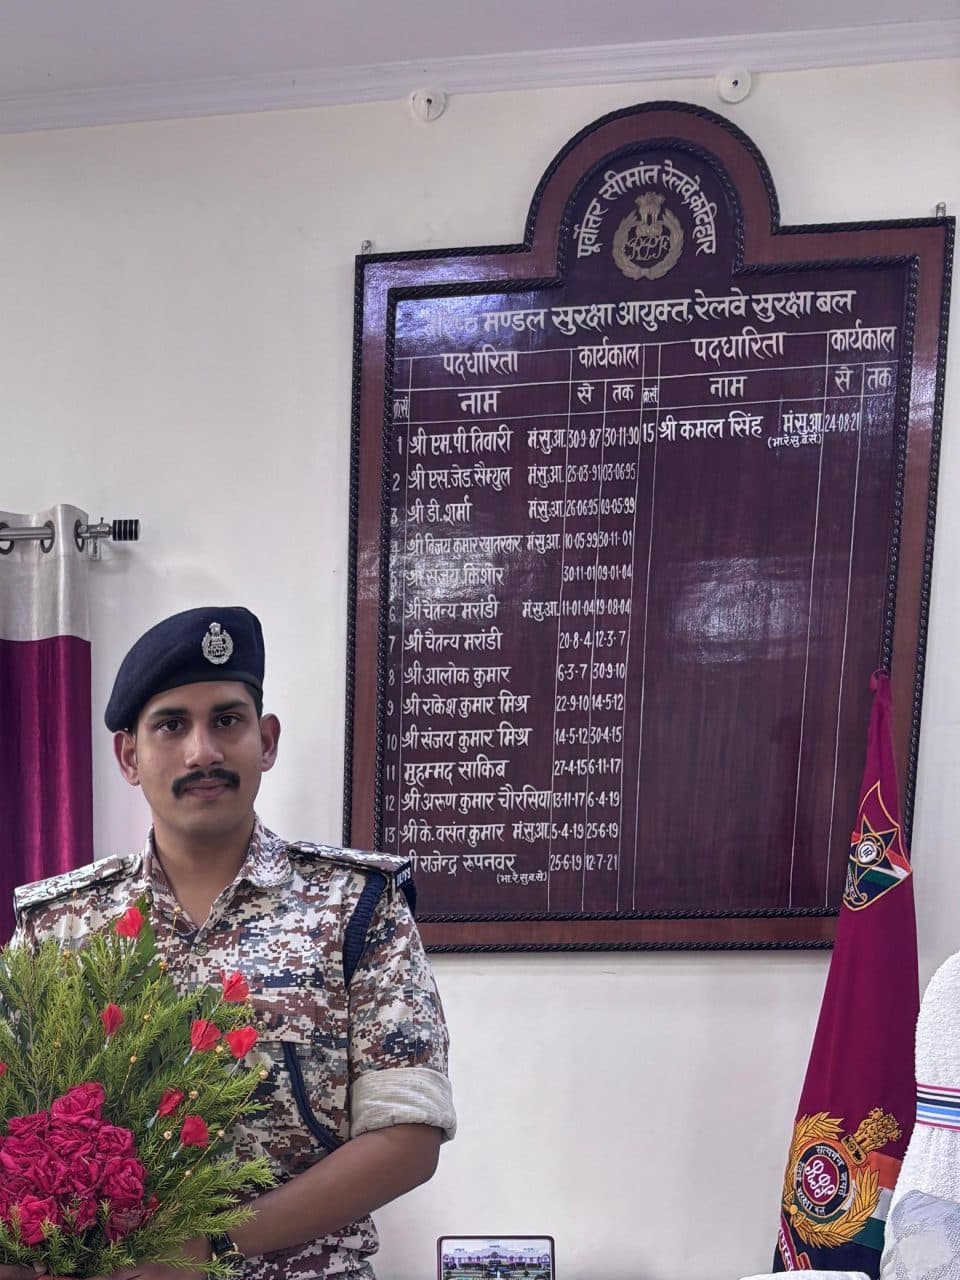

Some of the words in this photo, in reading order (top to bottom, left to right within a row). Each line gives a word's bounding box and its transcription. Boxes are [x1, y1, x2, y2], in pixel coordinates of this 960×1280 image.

[598, 161, 661, 200] सीमांत
[690, 192, 717, 256] कटिहार
[483, 309, 548, 332] मण्डल
[552, 304, 617, 335] सुरक्षा
[694, 288, 750, 321] रेलवे
[752, 291, 815, 323] सुरक्षा
[816, 290, 856, 314] बल
[829, 319, 897, 352] कार्यकाल
[578, 336, 640, 368] कार्यकाल
[709, 376, 748, 398] नाम
[835, 367, 854, 392] से
[867, 367, 892, 390] तक
[458, 390, 501, 415] नाम
[577, 383, 594, 404] से
[612, 384, 635, 403] तक
[642, 423, 655, 443] 15
[658, 415, 677, 441] श्री
[680, 418, 724, 439] कमल
[727, 410, 763, 438] सिंह
[397, 436, 403, 455] 1
[409, 427, 431, 457] श्री
[392, 473, 400, 492] 2
[408, 463, 427, 491] श्री
[407, 498, 427, 525] श्री
[406, 533, 426, 557] श्री
[404, 597, 422, 622] श्री
[422, 594, 459, 622] चैतन्य
[461, 594, 500, 620] मरांडी
[388, 636, 395, 652] 7
[404, 628, 424, 652] श्री
[425, 628, 462, 652] चैतन्य
[463, 626, 504, 650] मरांडी
[388, 670, 395, 686] 8
[403, 660, 423, 686] श्री
[423, 662, 470, 686] आलोक
[472, 666, 512, 689] कुमार
[387, 700, 394, 717] 9
[402, 692, 421, 717] श्री
[421, 694, 457, 718] राकेश
[458, 696, 496, 718] कुमार
[498, 690, 531, 714] मिश्र
[386, 734, 397, 751] 10
[401, 724, 420, 751] श्री
[420, 727, 457, 750] संजय
[458, 729, 495, 753] कुमार
[496, 721, 533, 747] मिश्र
[386, 763, 395, 781] 11
[404, 762, 456, 787] मुहम्मद
[458, 754, 510, 781] साकिब
[384, 795, 395, 812] 12
[401, 787, 420, 813] श्री
[459, 792, 496, 815] कुमार
[497, 784, 553, 812] चौरसिया
[384, 826, 395, 844] 13
[400, 819, 420, 844] श्री
[468, 823, 505, 848] कुमार
[420, 850, 459, 877] राजेन्द्र
